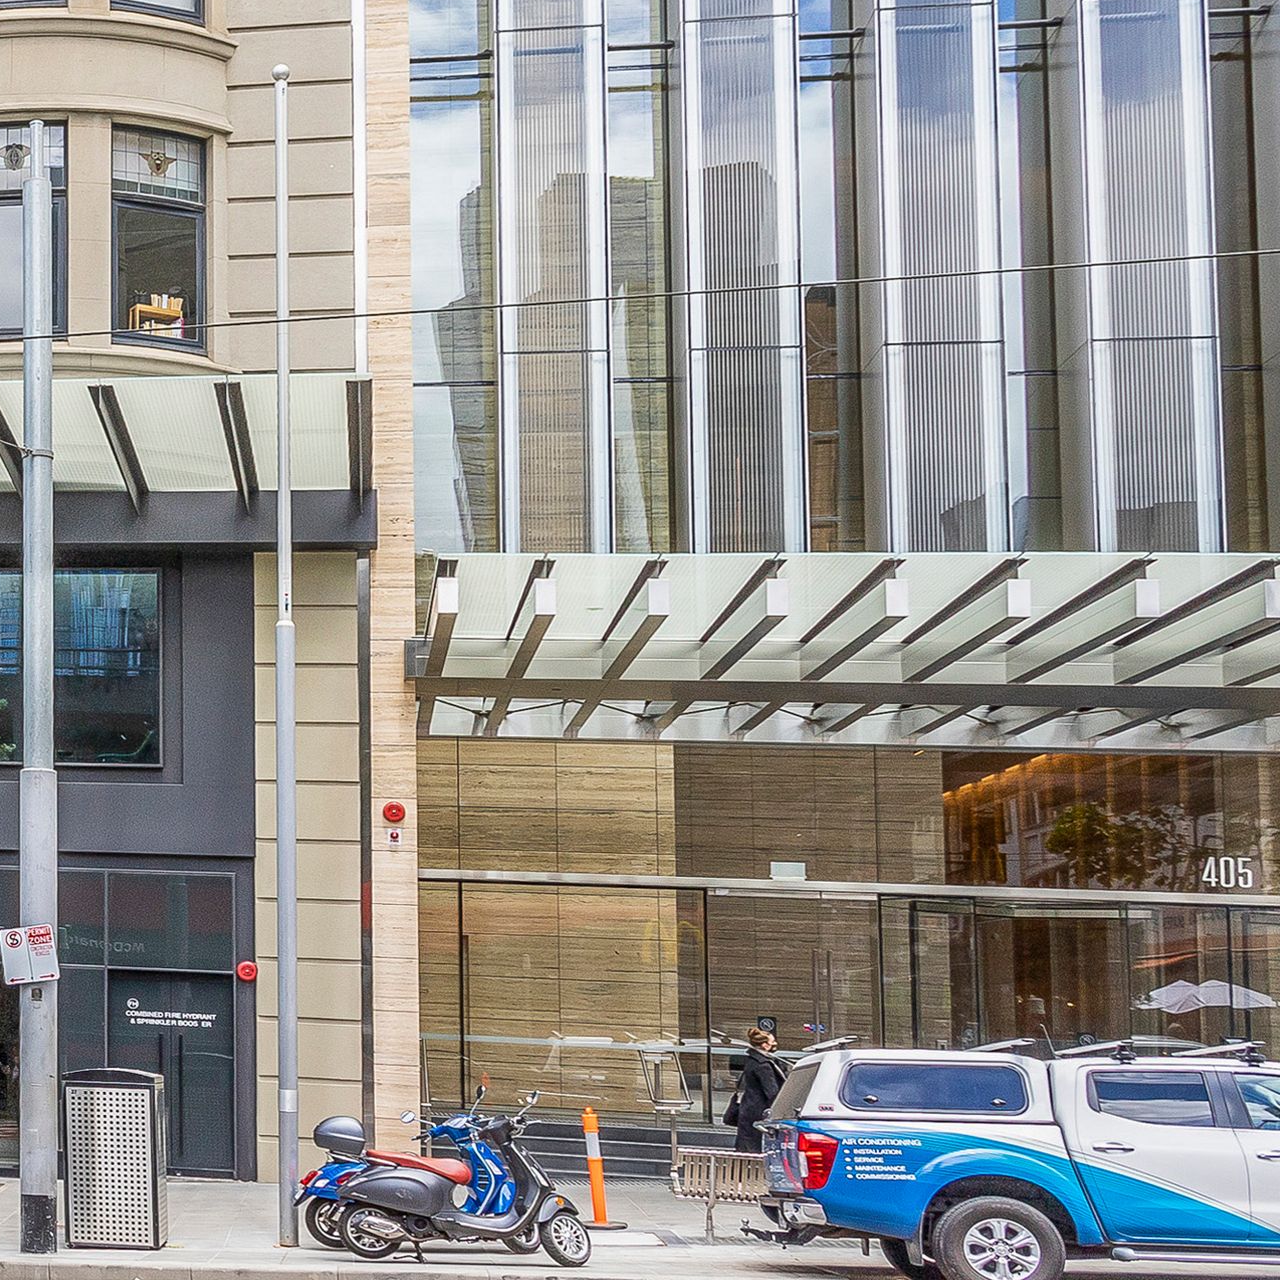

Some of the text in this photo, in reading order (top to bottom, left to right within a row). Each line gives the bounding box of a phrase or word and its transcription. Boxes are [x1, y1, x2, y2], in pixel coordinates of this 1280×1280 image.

[1201, 856, 1254, 889] 405
[26, 926, 52, 938] PERMIT
[28, 935, 53, 946] ZONE
[125, 1009, 217, 1021] COMBINED FIRE HYDRANT
[136, 1018, 178, 1027] SPRINKLER
[177, 1020, 213, 1028] BOOSER
[858, 1139, 922, 1147] CONDITIONING
[852, 1148, 902, 1156] INSTALLATION
[855, 1173, 917, 1181] COMMISSIONING
